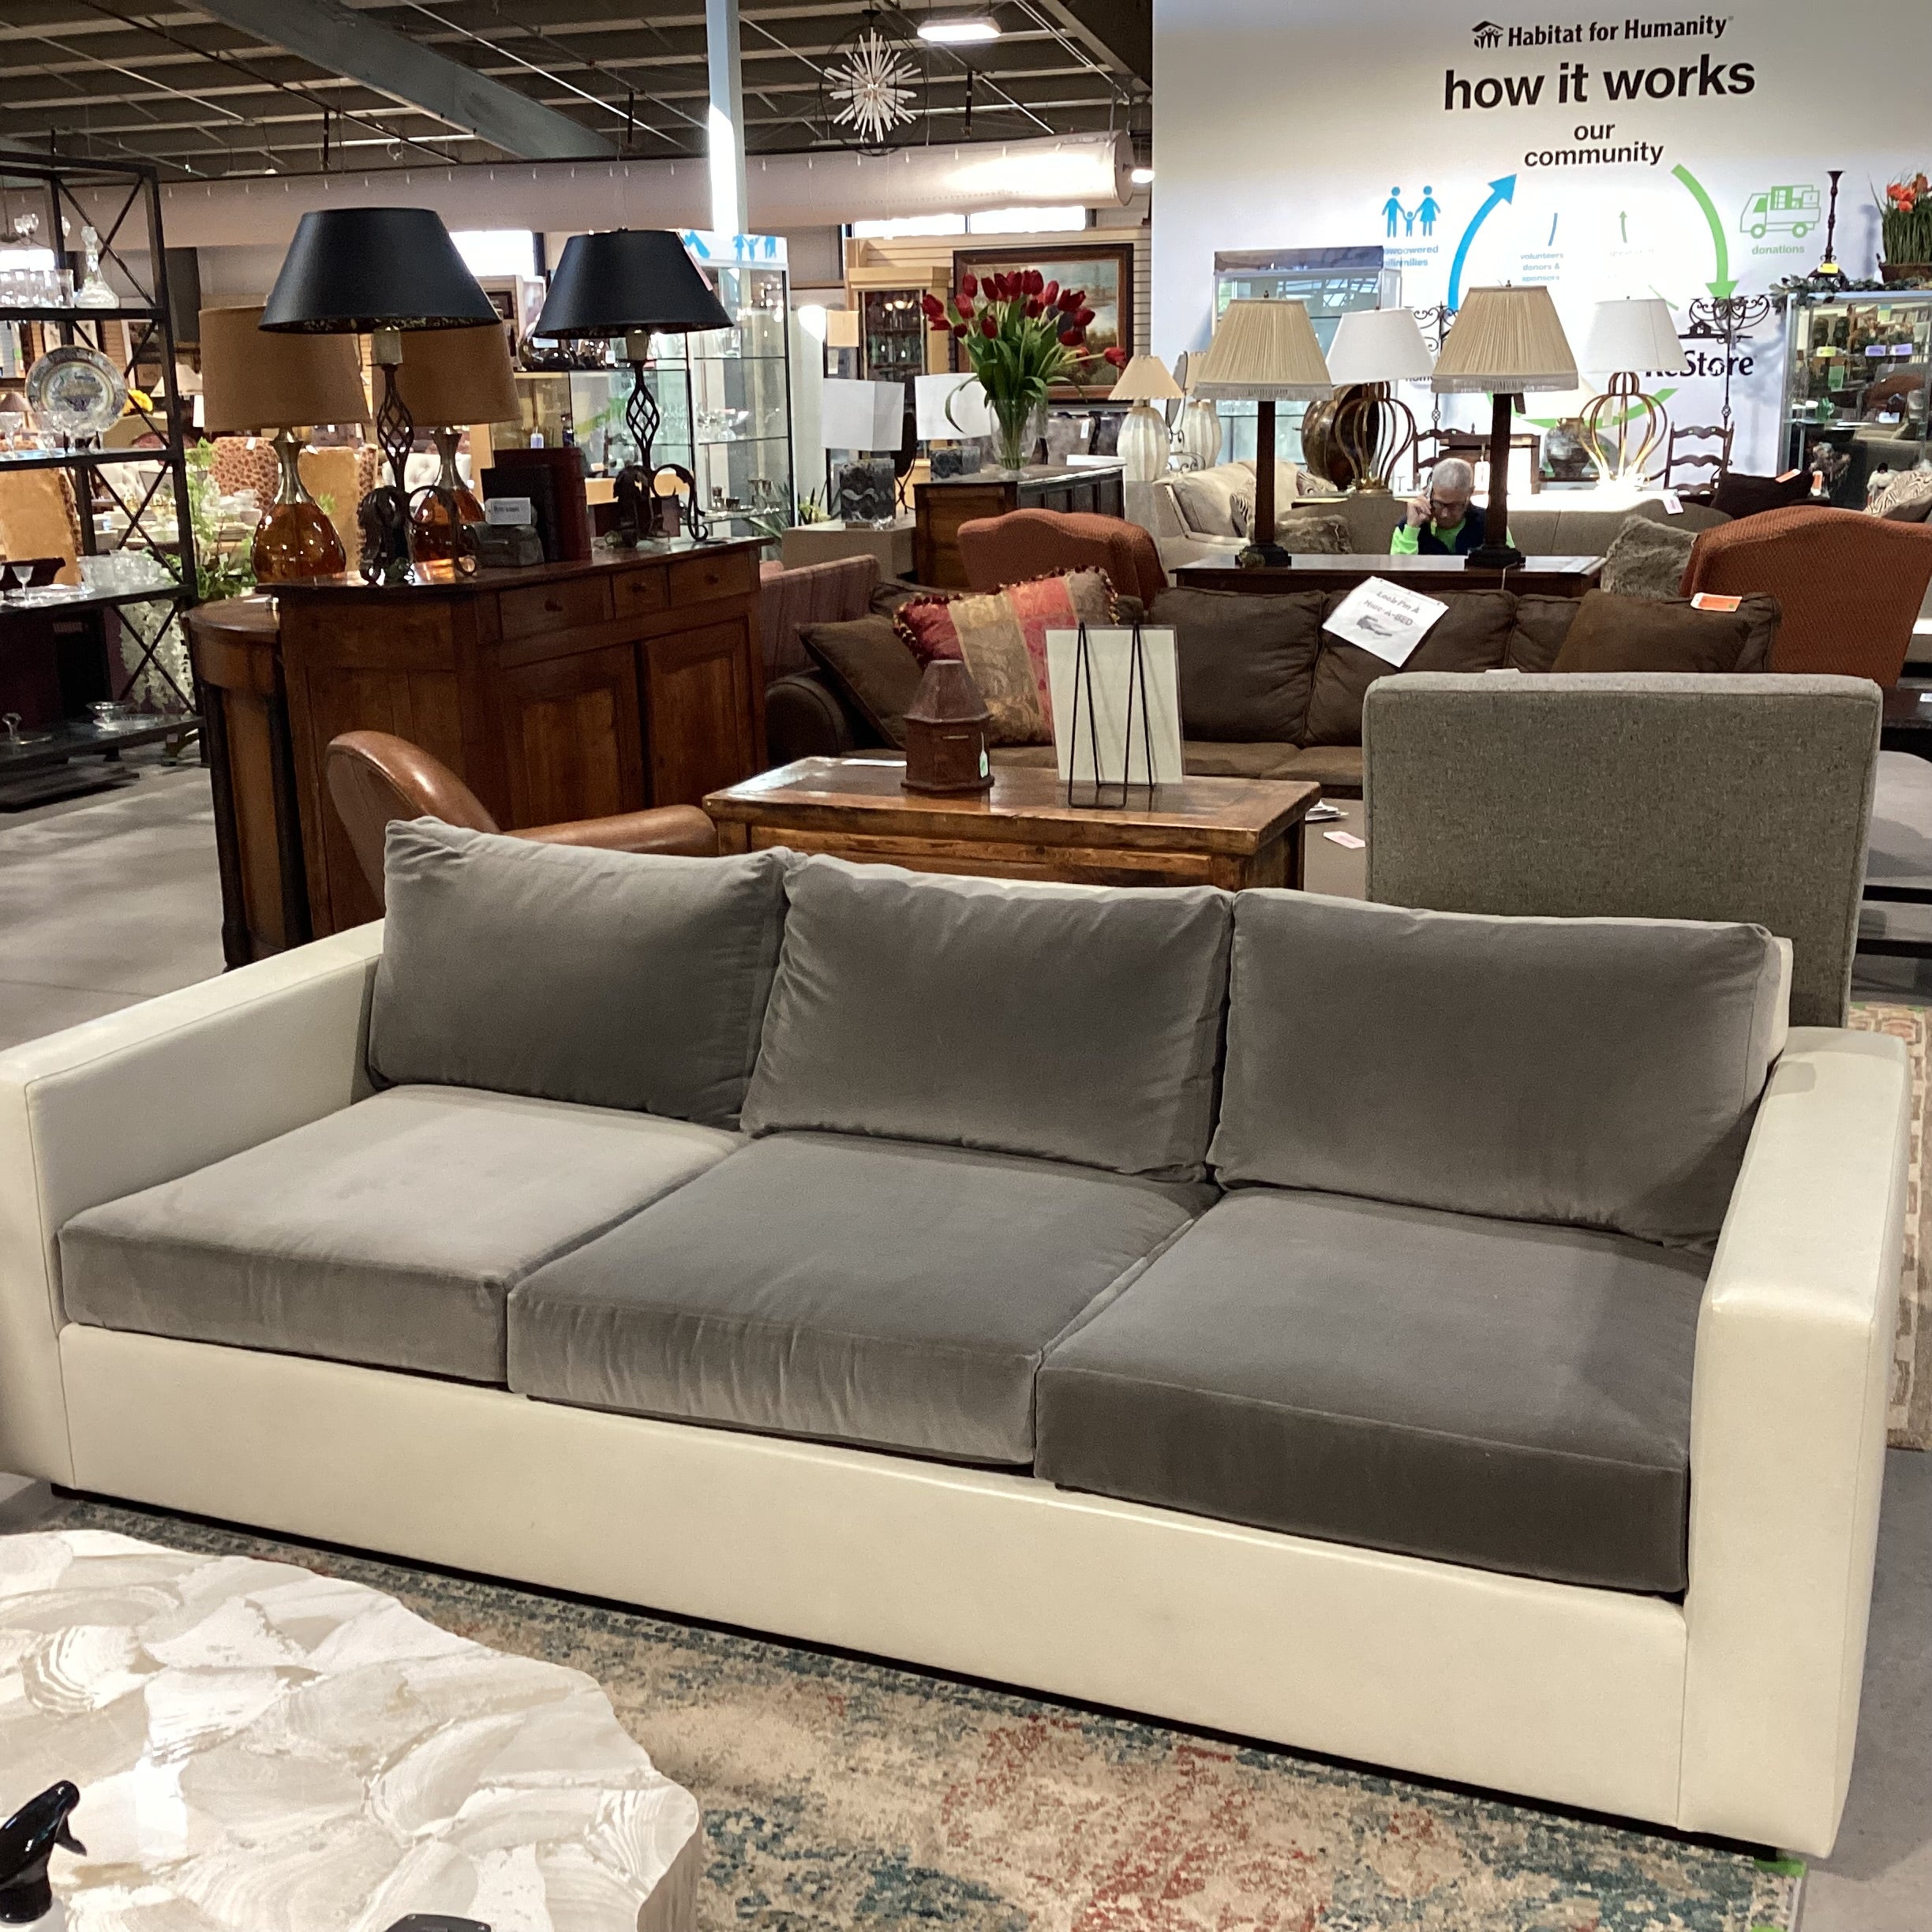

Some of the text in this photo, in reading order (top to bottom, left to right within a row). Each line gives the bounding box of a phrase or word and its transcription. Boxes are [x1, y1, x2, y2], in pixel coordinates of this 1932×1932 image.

[1508, 14, 1728, 47] Habitat for Humanity
[1444, 53, 1755, 110] how it works
[1574, 123, 1616, 141] our
[1524, 140, 1664, 167] community
[1520, 252, 1563, 260] volunteers
[1751, 244, 1805, 255] donations
[1646, 350, 1754, 378] Store
